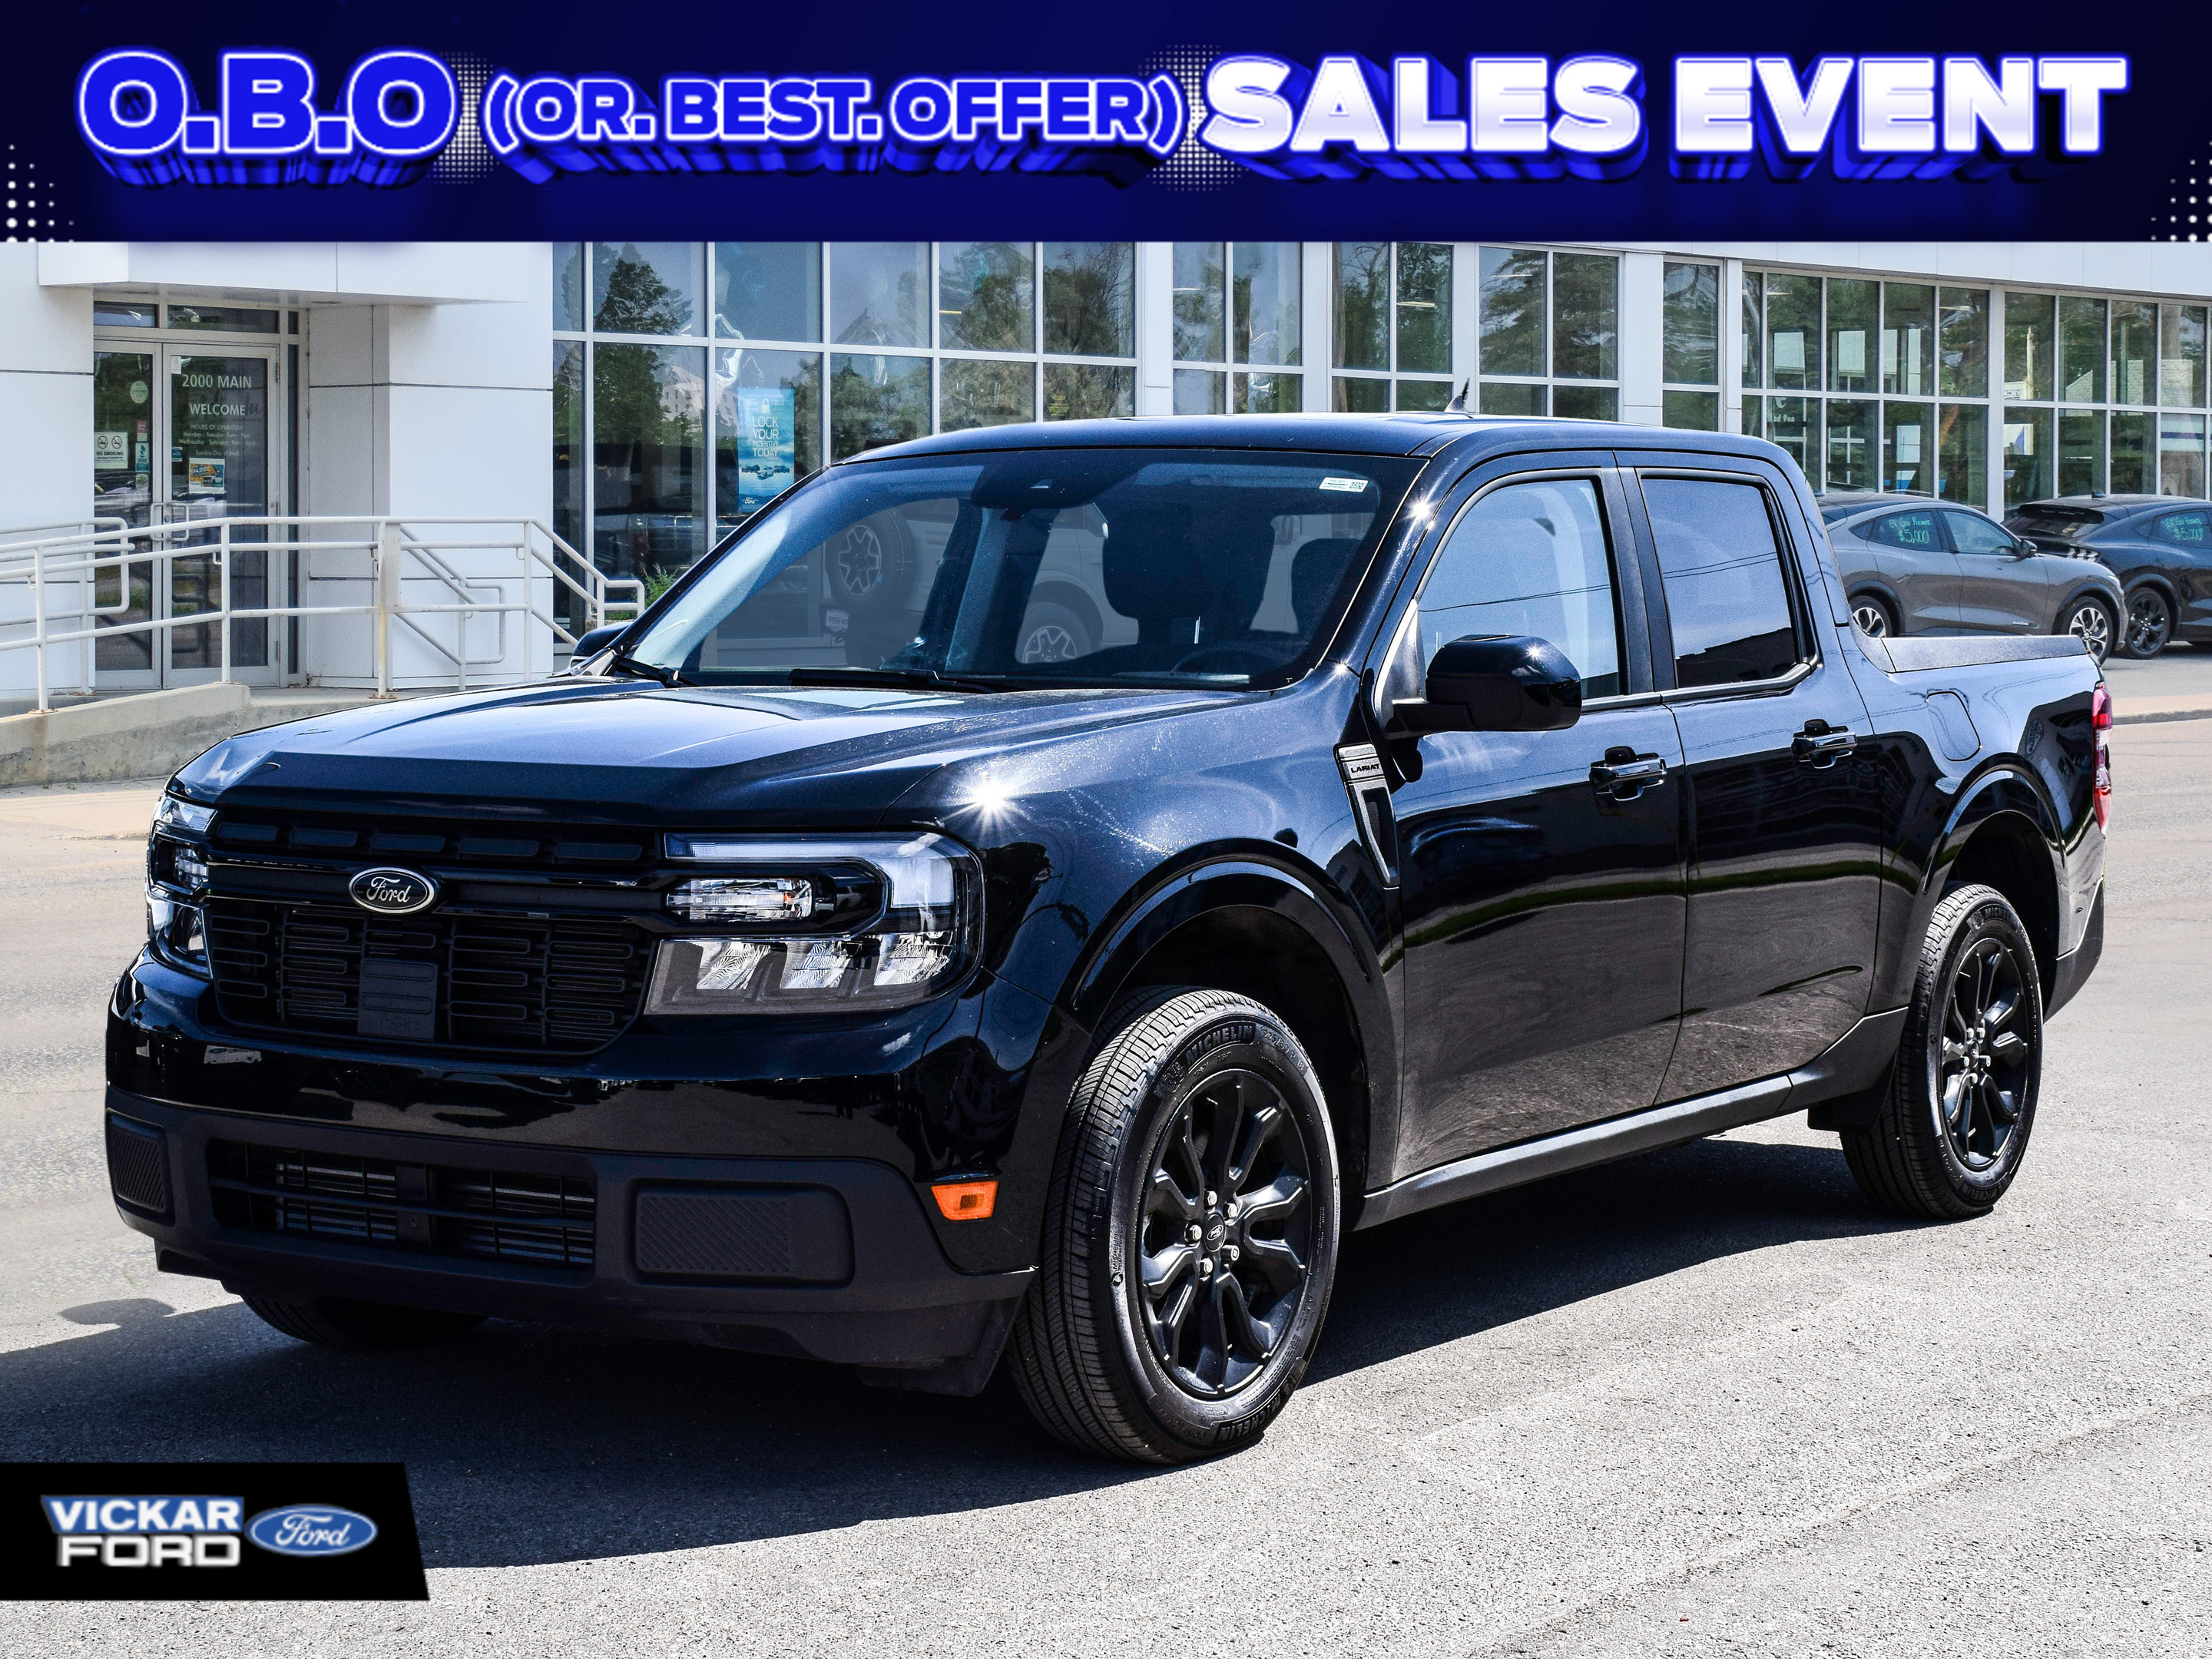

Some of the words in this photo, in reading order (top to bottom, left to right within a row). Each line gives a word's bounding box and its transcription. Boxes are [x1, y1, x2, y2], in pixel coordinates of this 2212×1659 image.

[181, 374, 214, 388] 2000
[217, 376, 252, 389] MAIN
[189, 403, 246, 416] WELCOME
[753, 416, 779, 428] LOCK
[753, 429, 780, 439] YOUR
[753, 448, 778, 457] TODAY
[1351, 763, 1380, 773] LARIAT
[366, 876, 412, 902] Ford
[1186, 1025, 1253, 1065] MICHELIN
[1218, 1396, 1282, 1441] MICHELIN
